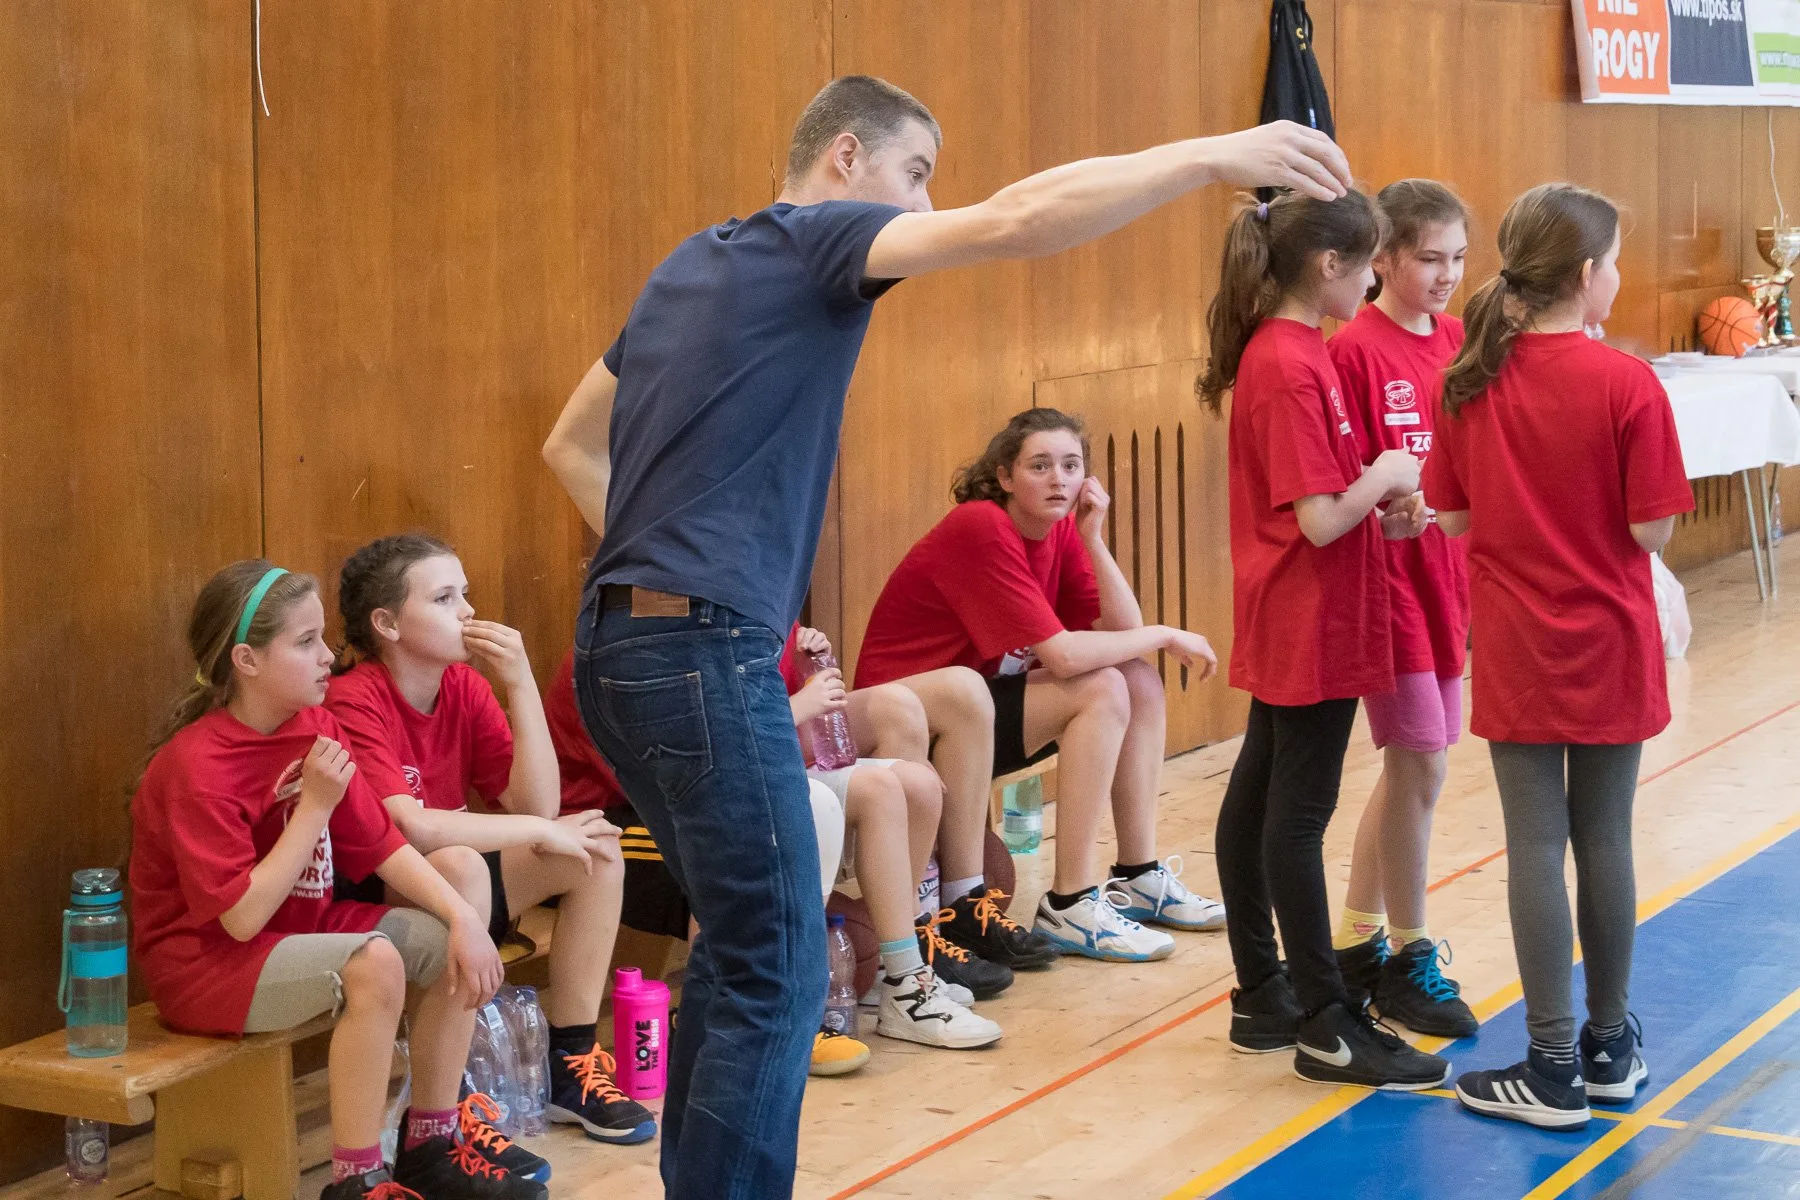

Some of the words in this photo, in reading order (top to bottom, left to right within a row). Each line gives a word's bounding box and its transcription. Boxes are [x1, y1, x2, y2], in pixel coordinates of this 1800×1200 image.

[1588, 28, 1660, 80] ROGY
[635, 1020, 650, 1071] LOVE
[651, 1050, 659, 1070] THE
